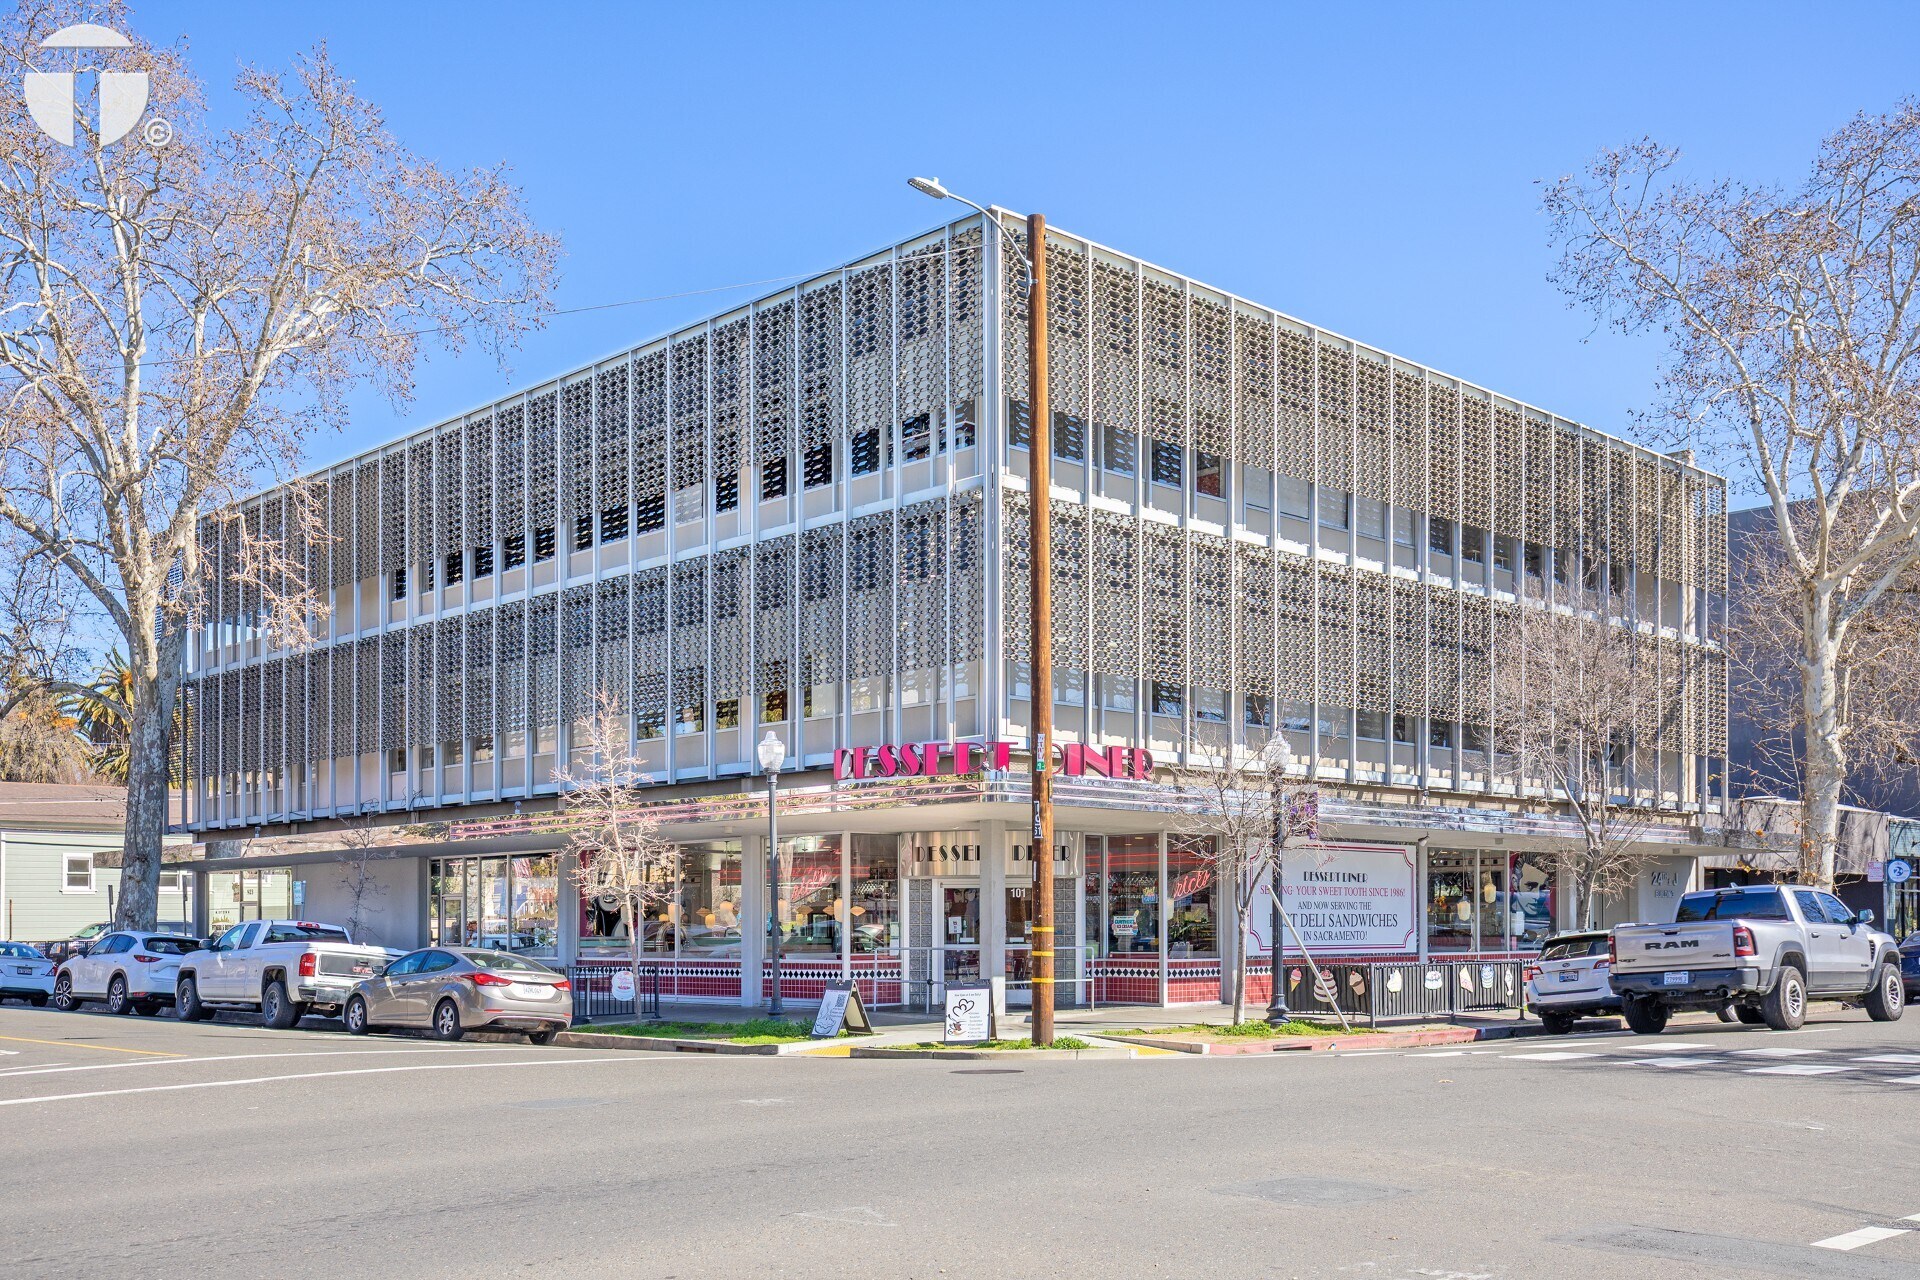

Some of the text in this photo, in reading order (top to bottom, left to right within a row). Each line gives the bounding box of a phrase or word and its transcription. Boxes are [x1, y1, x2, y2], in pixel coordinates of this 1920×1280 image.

[834, 742, 998, 780] DESSERT
[914, 844, 1071, 862] DESSE DIER
[1303, 871, 1368, 883] DESSERT DINER
[1010, 888, 1026, 898] 101
[1260, 884, 1405, 897] SENG YOUR SWEET TOOTH SINCE 1986!
[1298, 901, 1372, 910] AND NOW SERVING THE
[1300, 913, 1326, 927] DELI
[1328, 913, 1398, 928] SANDWICHES
[1303, 930, 1368, 941] IN SACRAMENTO!
[1645, 940, 1699, 950] RAM
